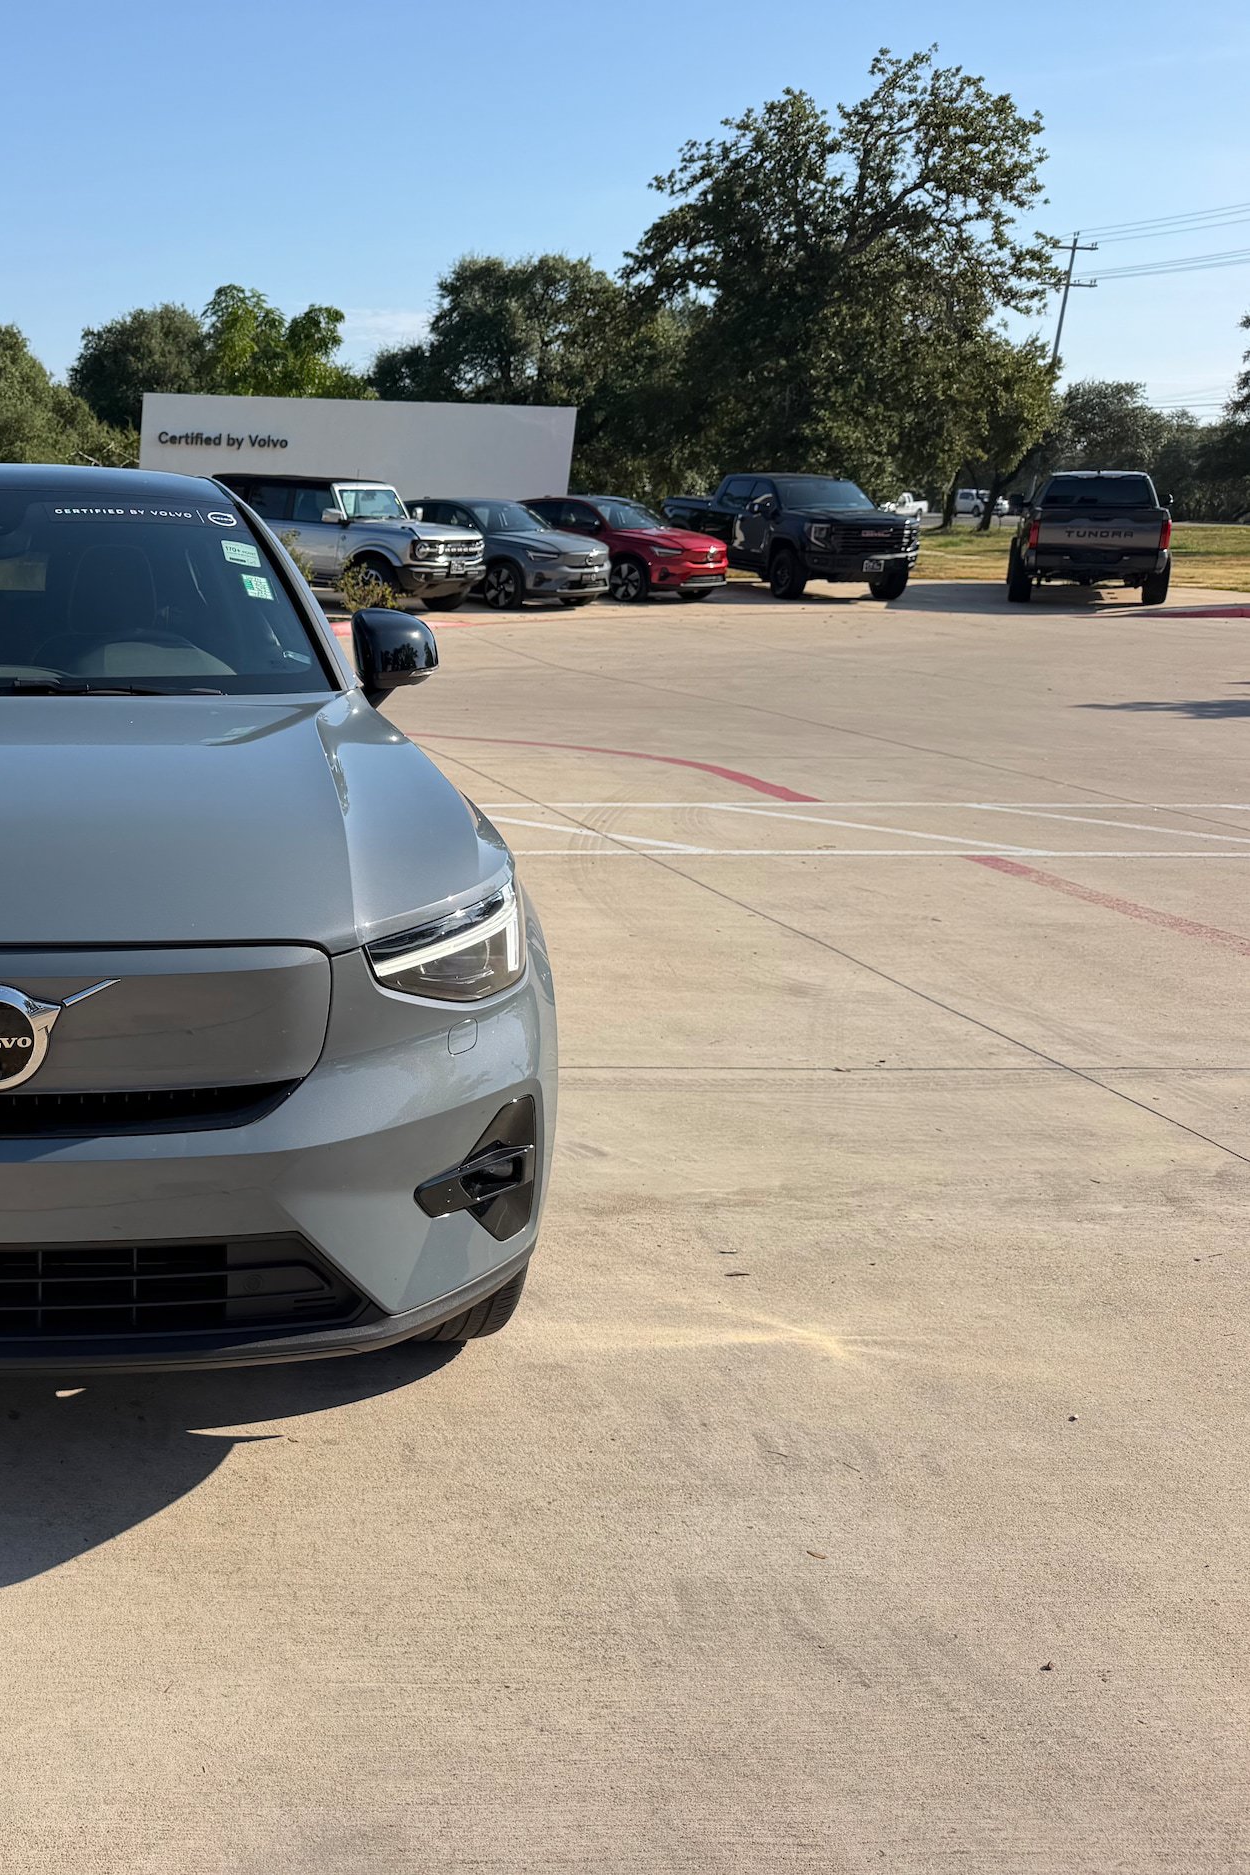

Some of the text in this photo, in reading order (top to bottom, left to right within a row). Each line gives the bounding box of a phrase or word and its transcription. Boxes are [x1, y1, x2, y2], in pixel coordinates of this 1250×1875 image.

[158, 431, 289, 450] Certified by Volvo
[150, 510, 193, 519] VOLVO
[1065, 530, 1134, 538] TUNDRA
